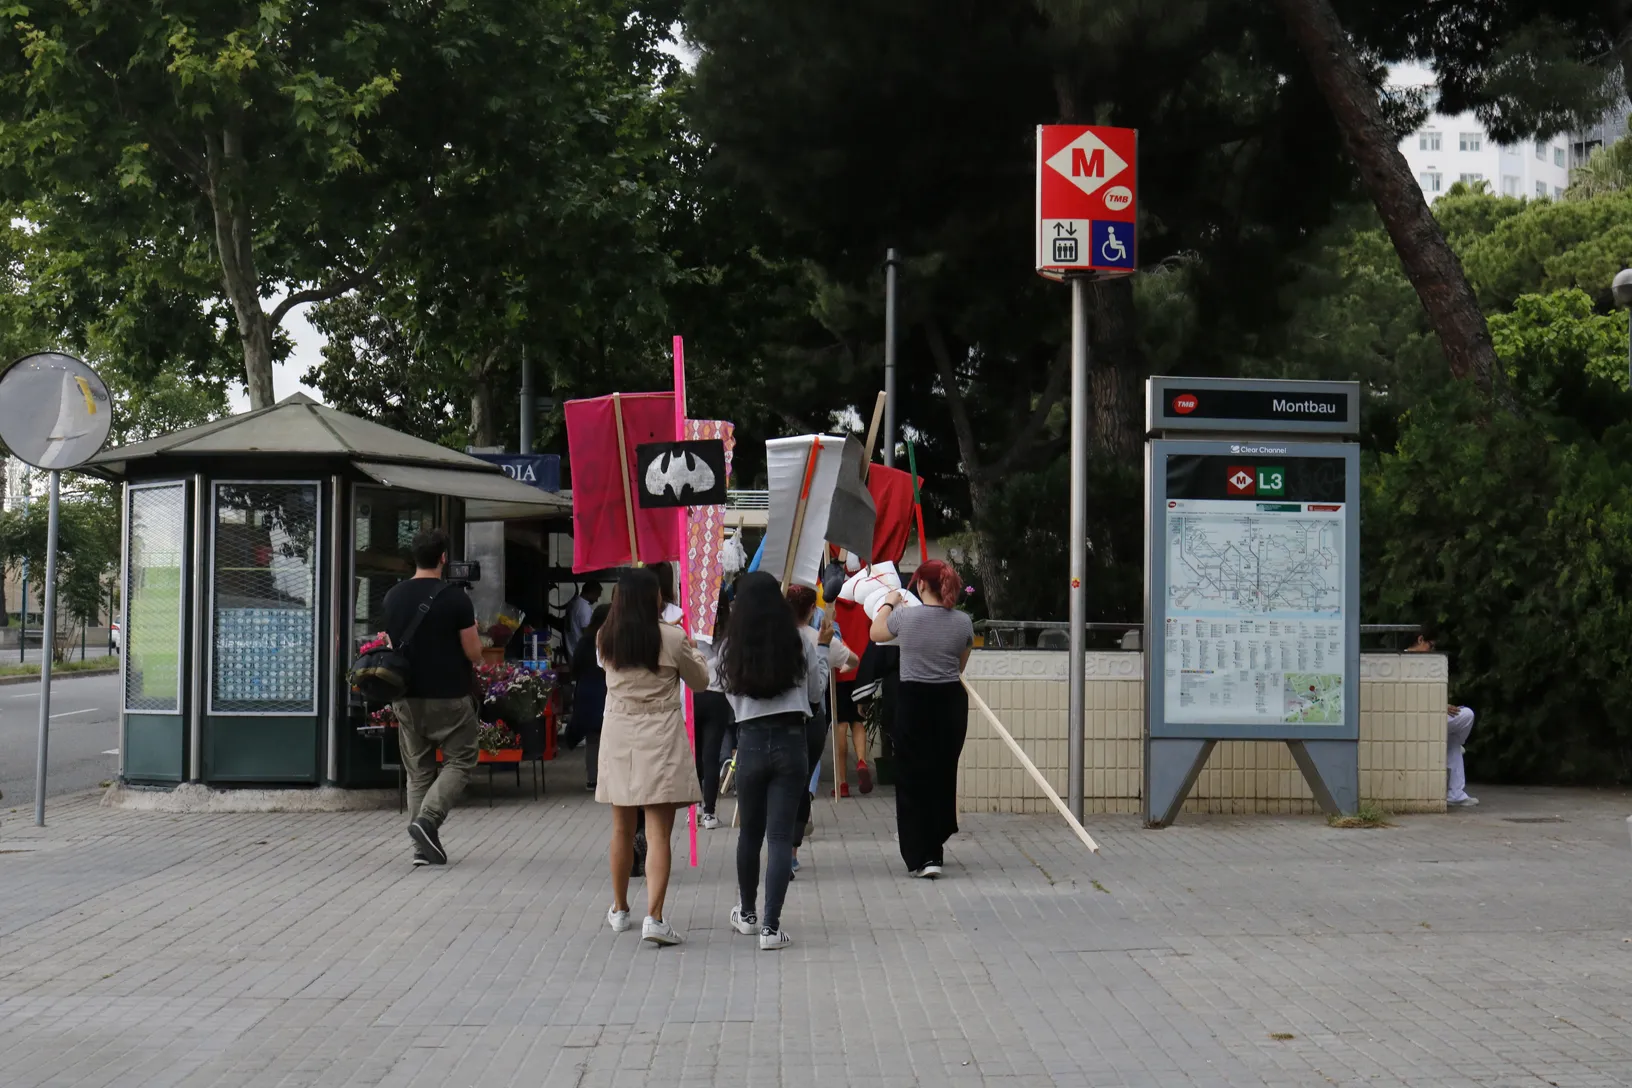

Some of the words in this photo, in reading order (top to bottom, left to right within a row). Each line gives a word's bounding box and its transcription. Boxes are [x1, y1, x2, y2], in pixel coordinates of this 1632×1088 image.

[1072, 148, 1105, 178] M
[1109, 194, 1129, 203] TMB
[1177, 400, 1195, 408] TMB
[1272, 399, 1336, 413] Montbau
[1259, 446, 1287, 454] Channel
[1236, 475, 1246, 485] M
[1259, 473, 1282, 490] L3
